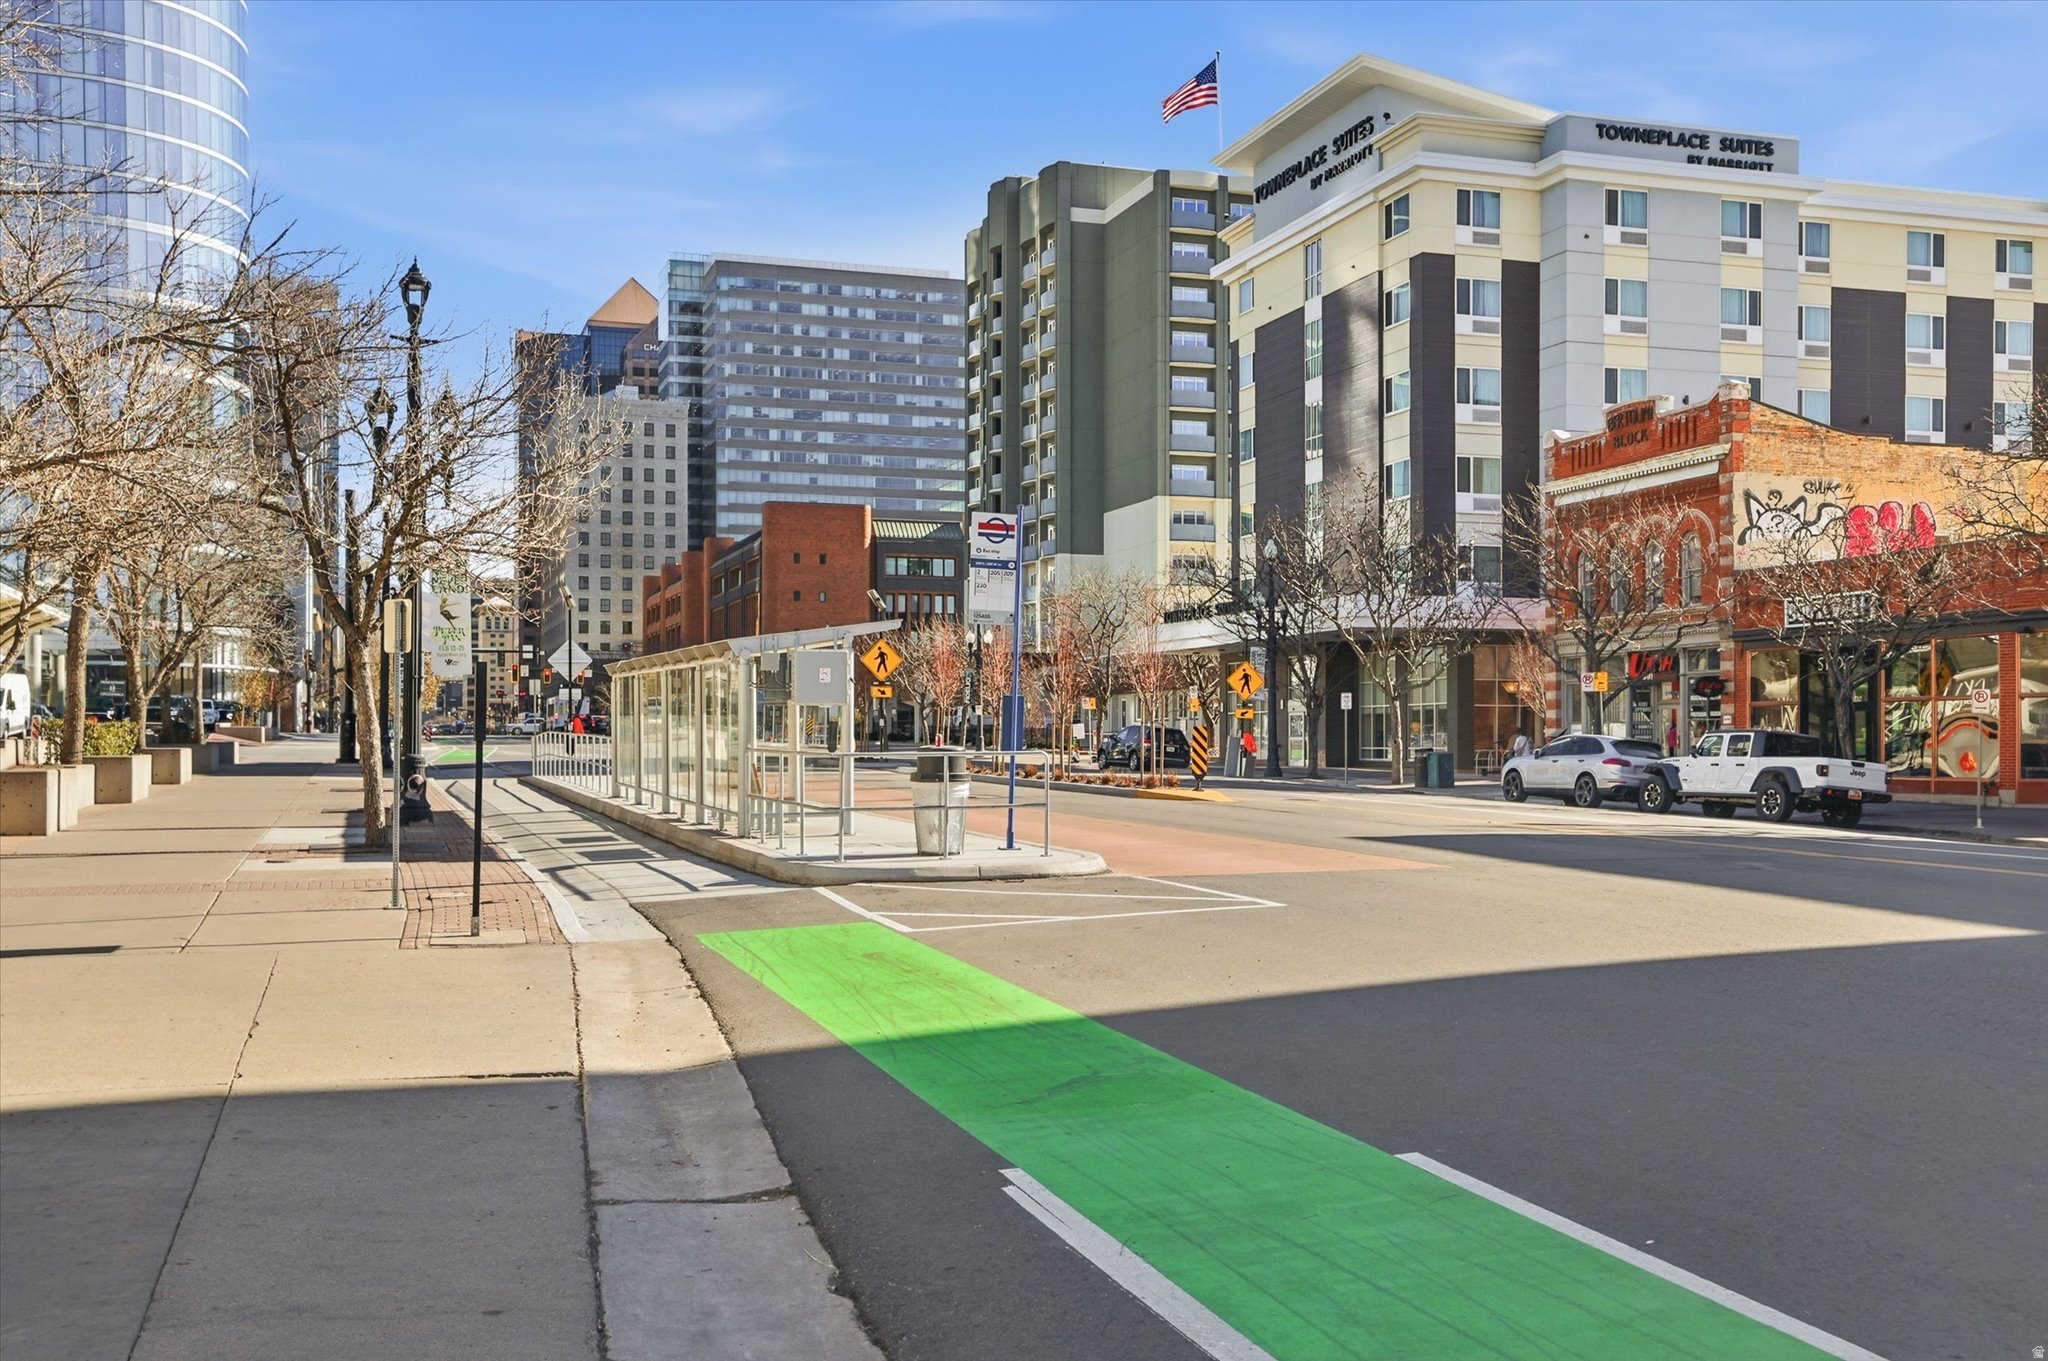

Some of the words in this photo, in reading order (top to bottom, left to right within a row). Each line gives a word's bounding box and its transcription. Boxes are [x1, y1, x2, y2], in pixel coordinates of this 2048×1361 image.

[1595, 123, 1710, 150] TOWNEPLACE
[1719, 136, 1775, 157] SUITES
[1254, 144, 1328, 204] TOWNEPLACE
[1332, 115, 1375, 156] SUITES
[1310, 173, 1324, 191] BY
[1324, 144, 1374, 182] MARRIOTT
[1687, 154, 1704, 165] BY
[1613, 429, 1649, 448] BLOCK
[1849, 768, 1867, 778] Jeep
